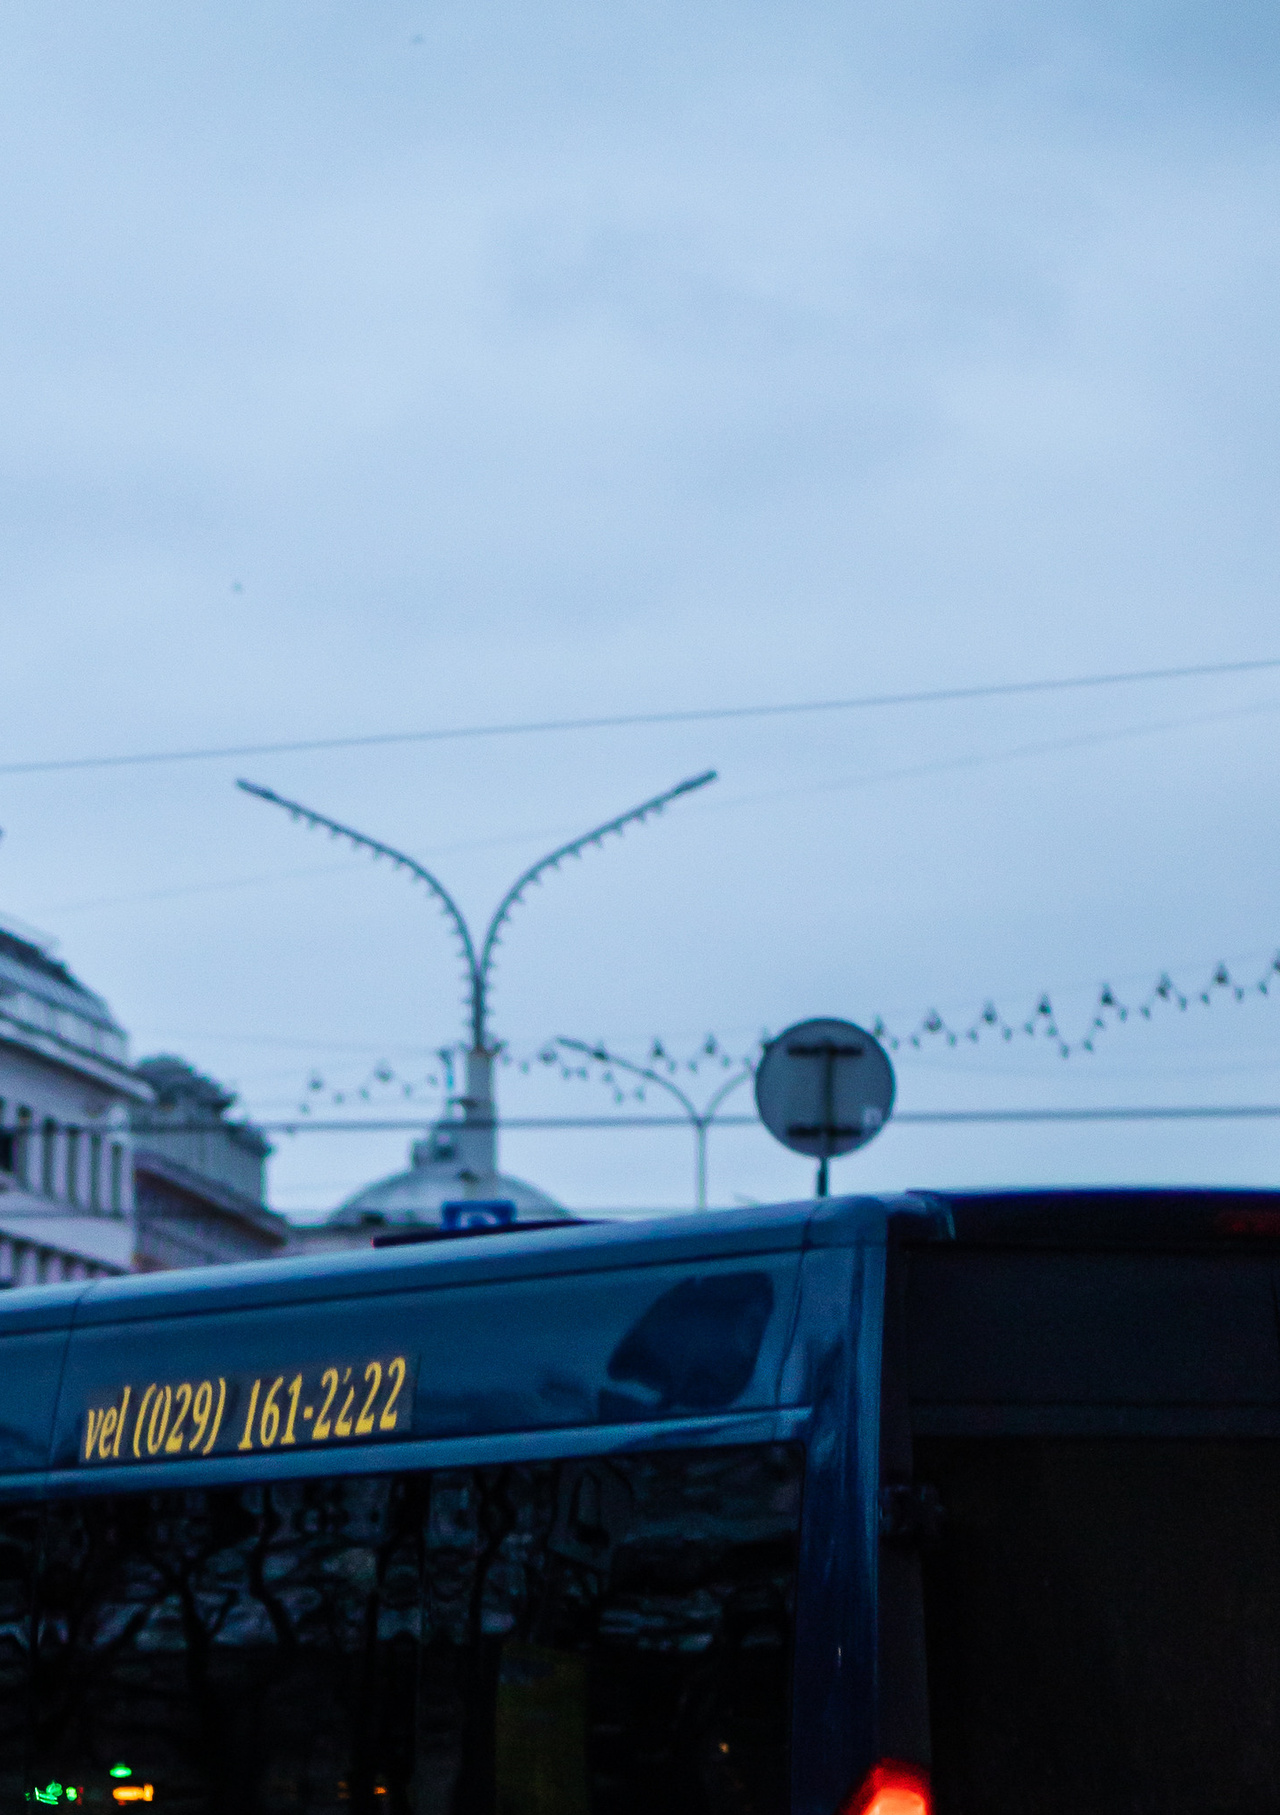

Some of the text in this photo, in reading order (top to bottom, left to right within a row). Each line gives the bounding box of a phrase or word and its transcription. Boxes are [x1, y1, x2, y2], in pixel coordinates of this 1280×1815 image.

[85, 1357, 406, 1460] vel (029) 161-2222
